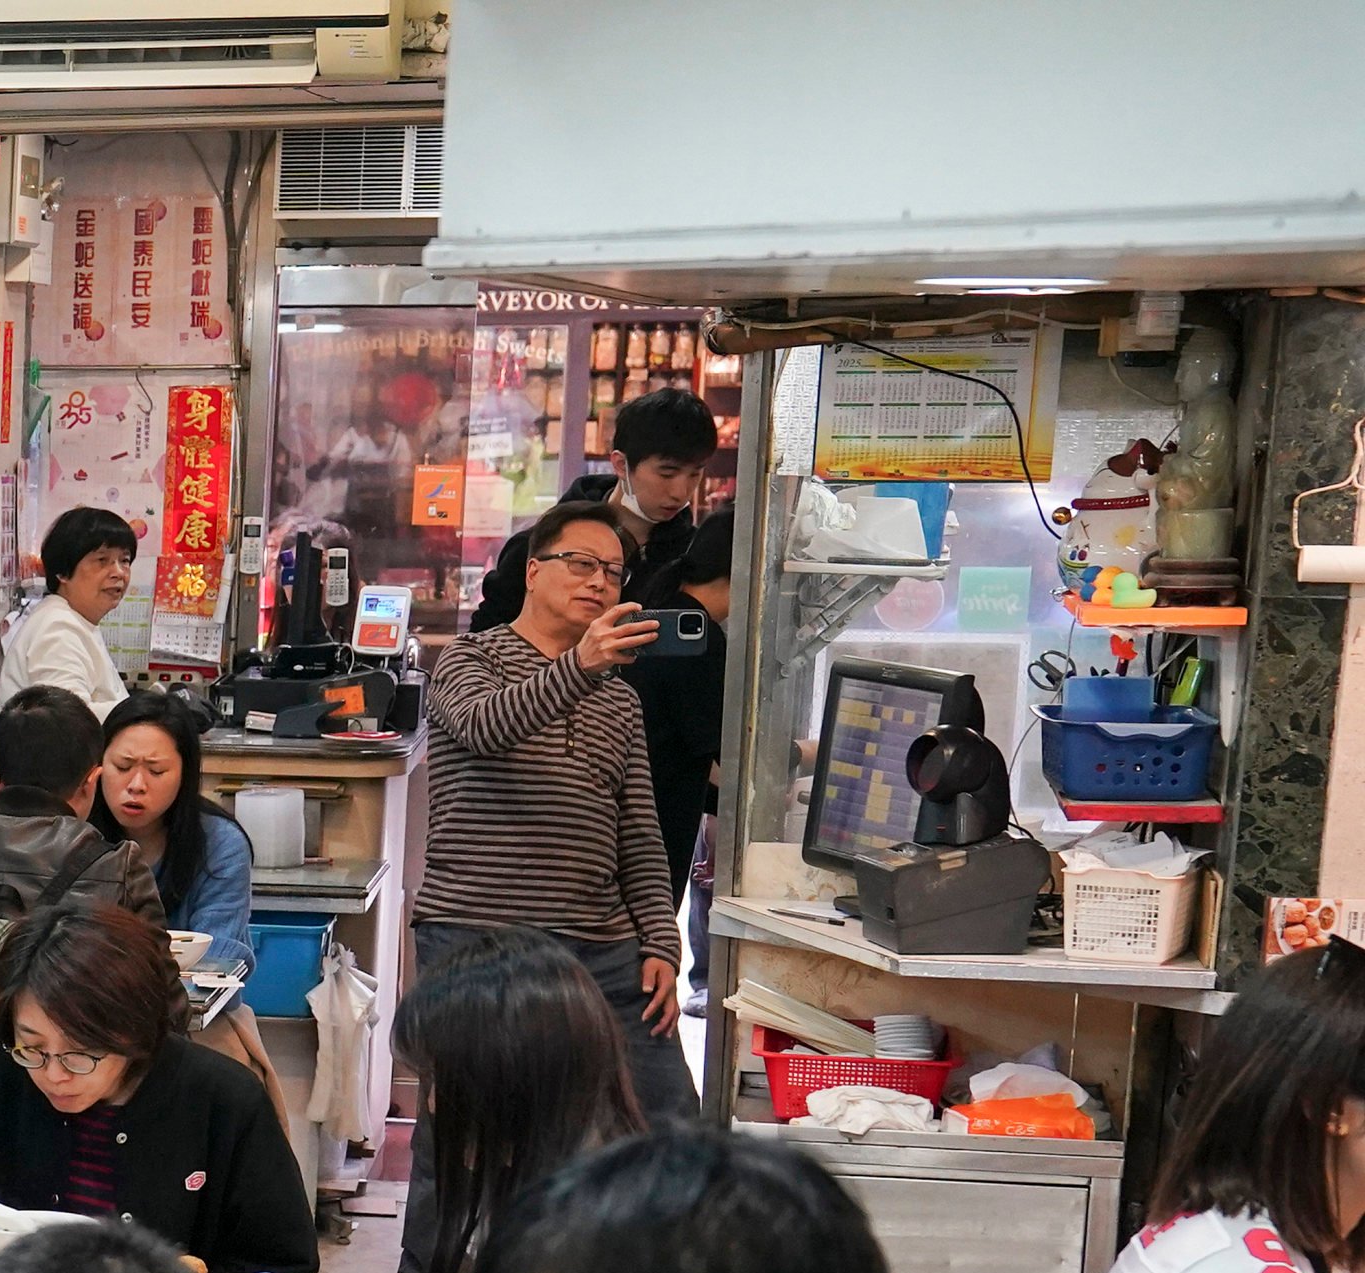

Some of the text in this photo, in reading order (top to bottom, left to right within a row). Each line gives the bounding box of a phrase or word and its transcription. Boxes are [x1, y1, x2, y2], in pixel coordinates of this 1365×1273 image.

[131, 208, 155, 329] 國泰民安
[496, 335, 565, 364] Sweets
[837, 358, 862, 368] 2025
[173, 390, 217, 550] 身體健康
[176, 563, 207, 597] 福
[1004, 1125, 1037, 1136] C&S
